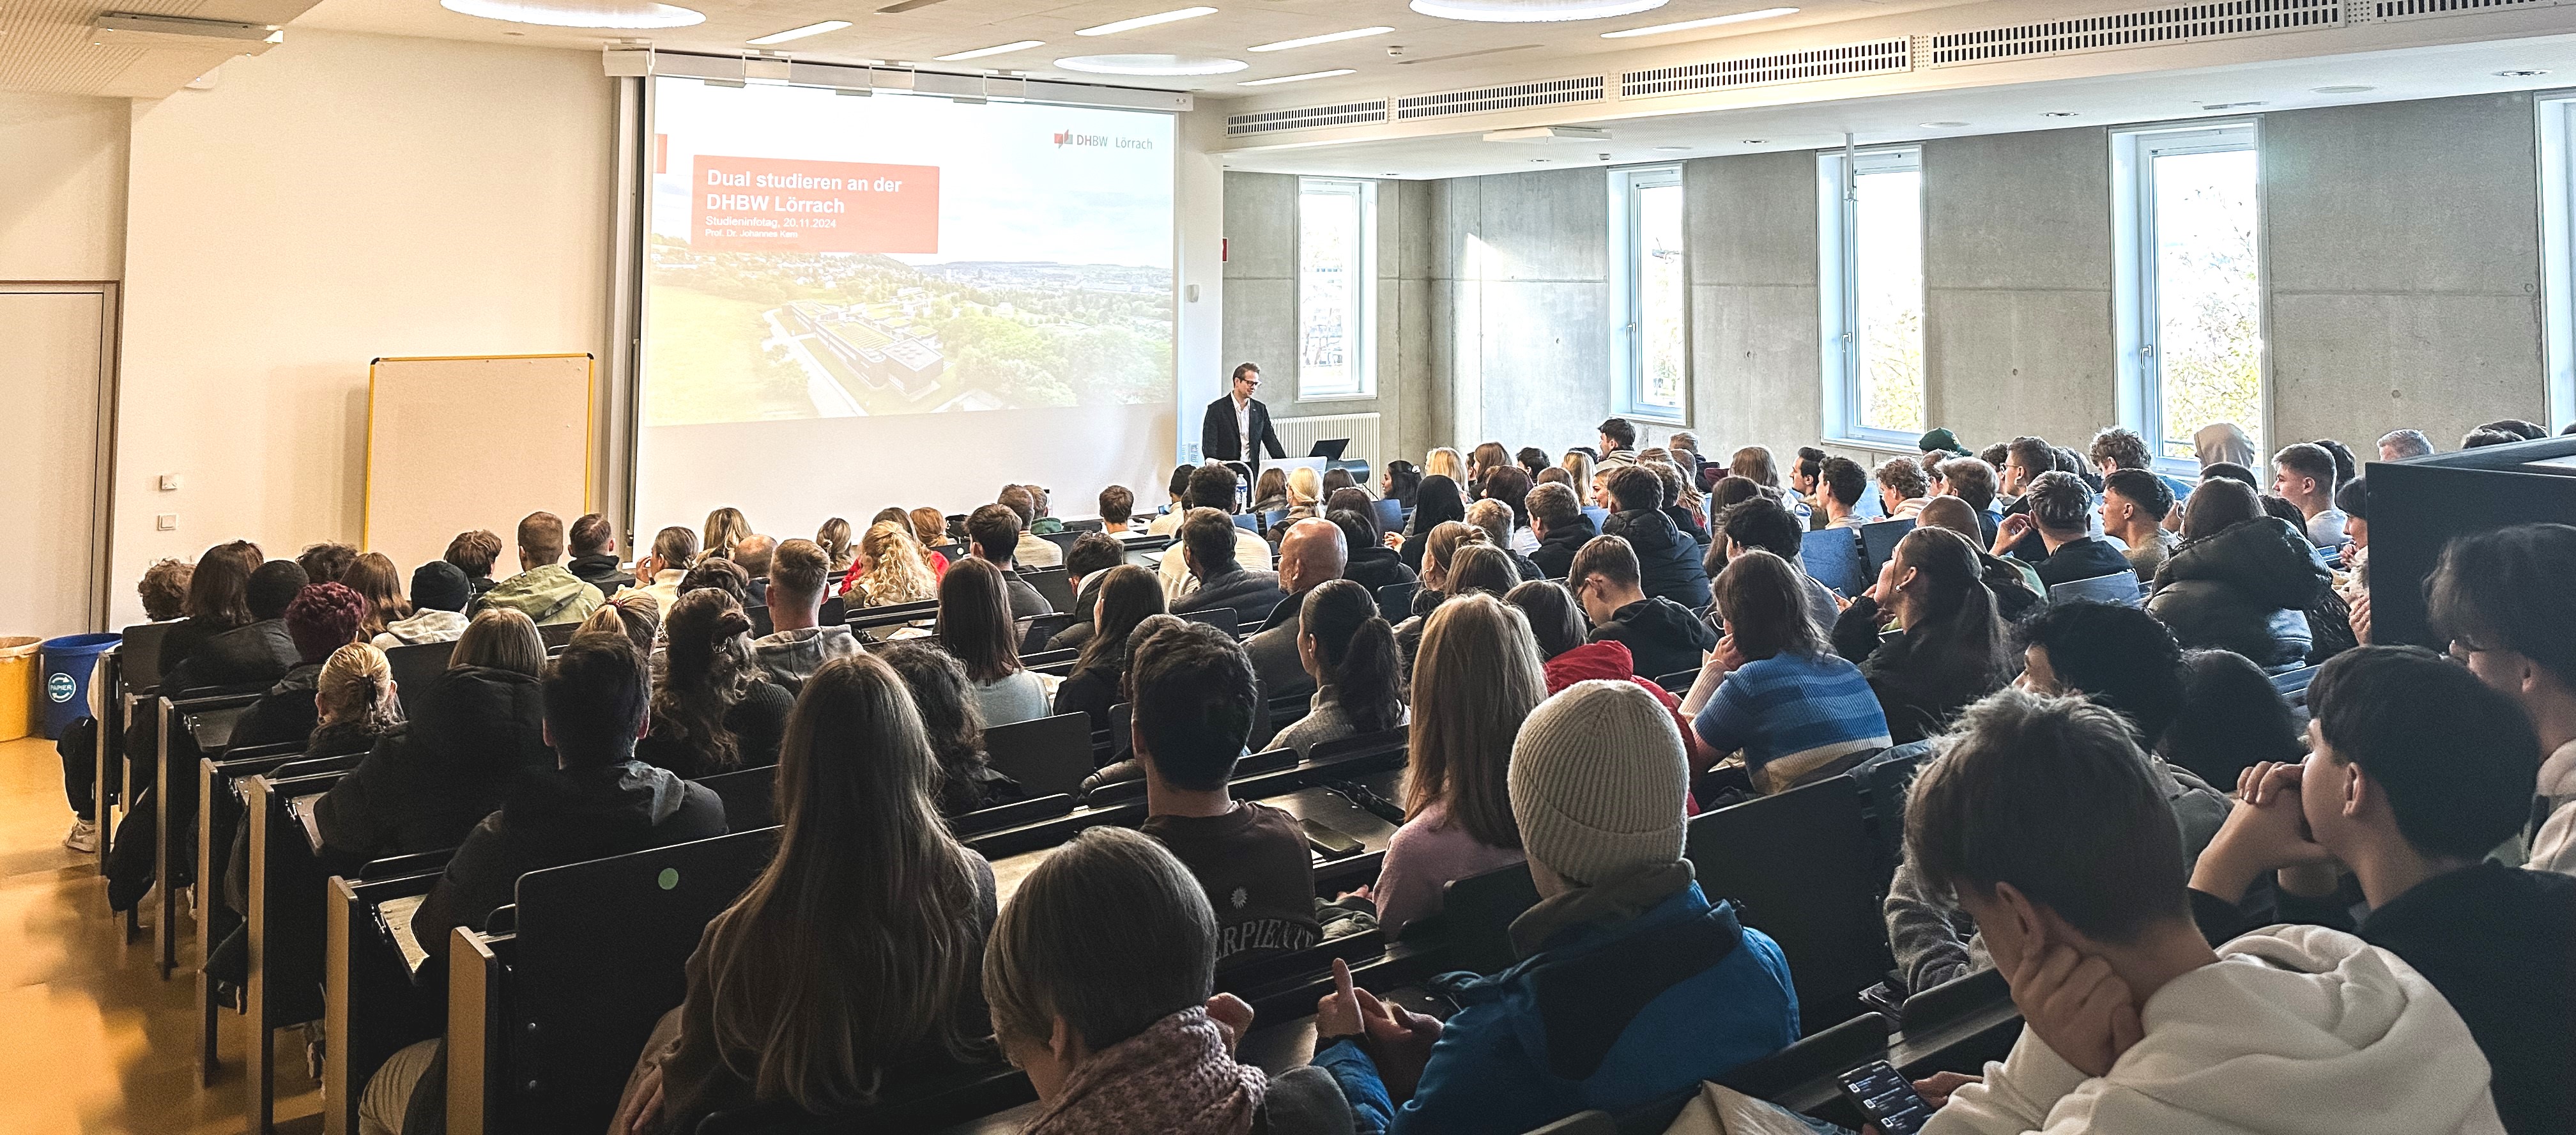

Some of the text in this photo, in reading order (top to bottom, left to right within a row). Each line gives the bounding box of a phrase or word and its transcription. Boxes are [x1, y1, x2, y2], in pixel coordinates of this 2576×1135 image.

[1077, 135, 1153, 150] DHBW Lörrach
[707, 169, 902, 192] Dual studieren an der
[707, 194, 845, 213] DHBW Lörrach
[705, 215, 836, 229] Studieninfotag, 20.11.2024
[705, 228, 724, 237] Prof.
[726, 229, 738, 237] Dr.
[739, 229, 778, 238] Johannes
[1215, 918, 1314, 961] RPIENT
